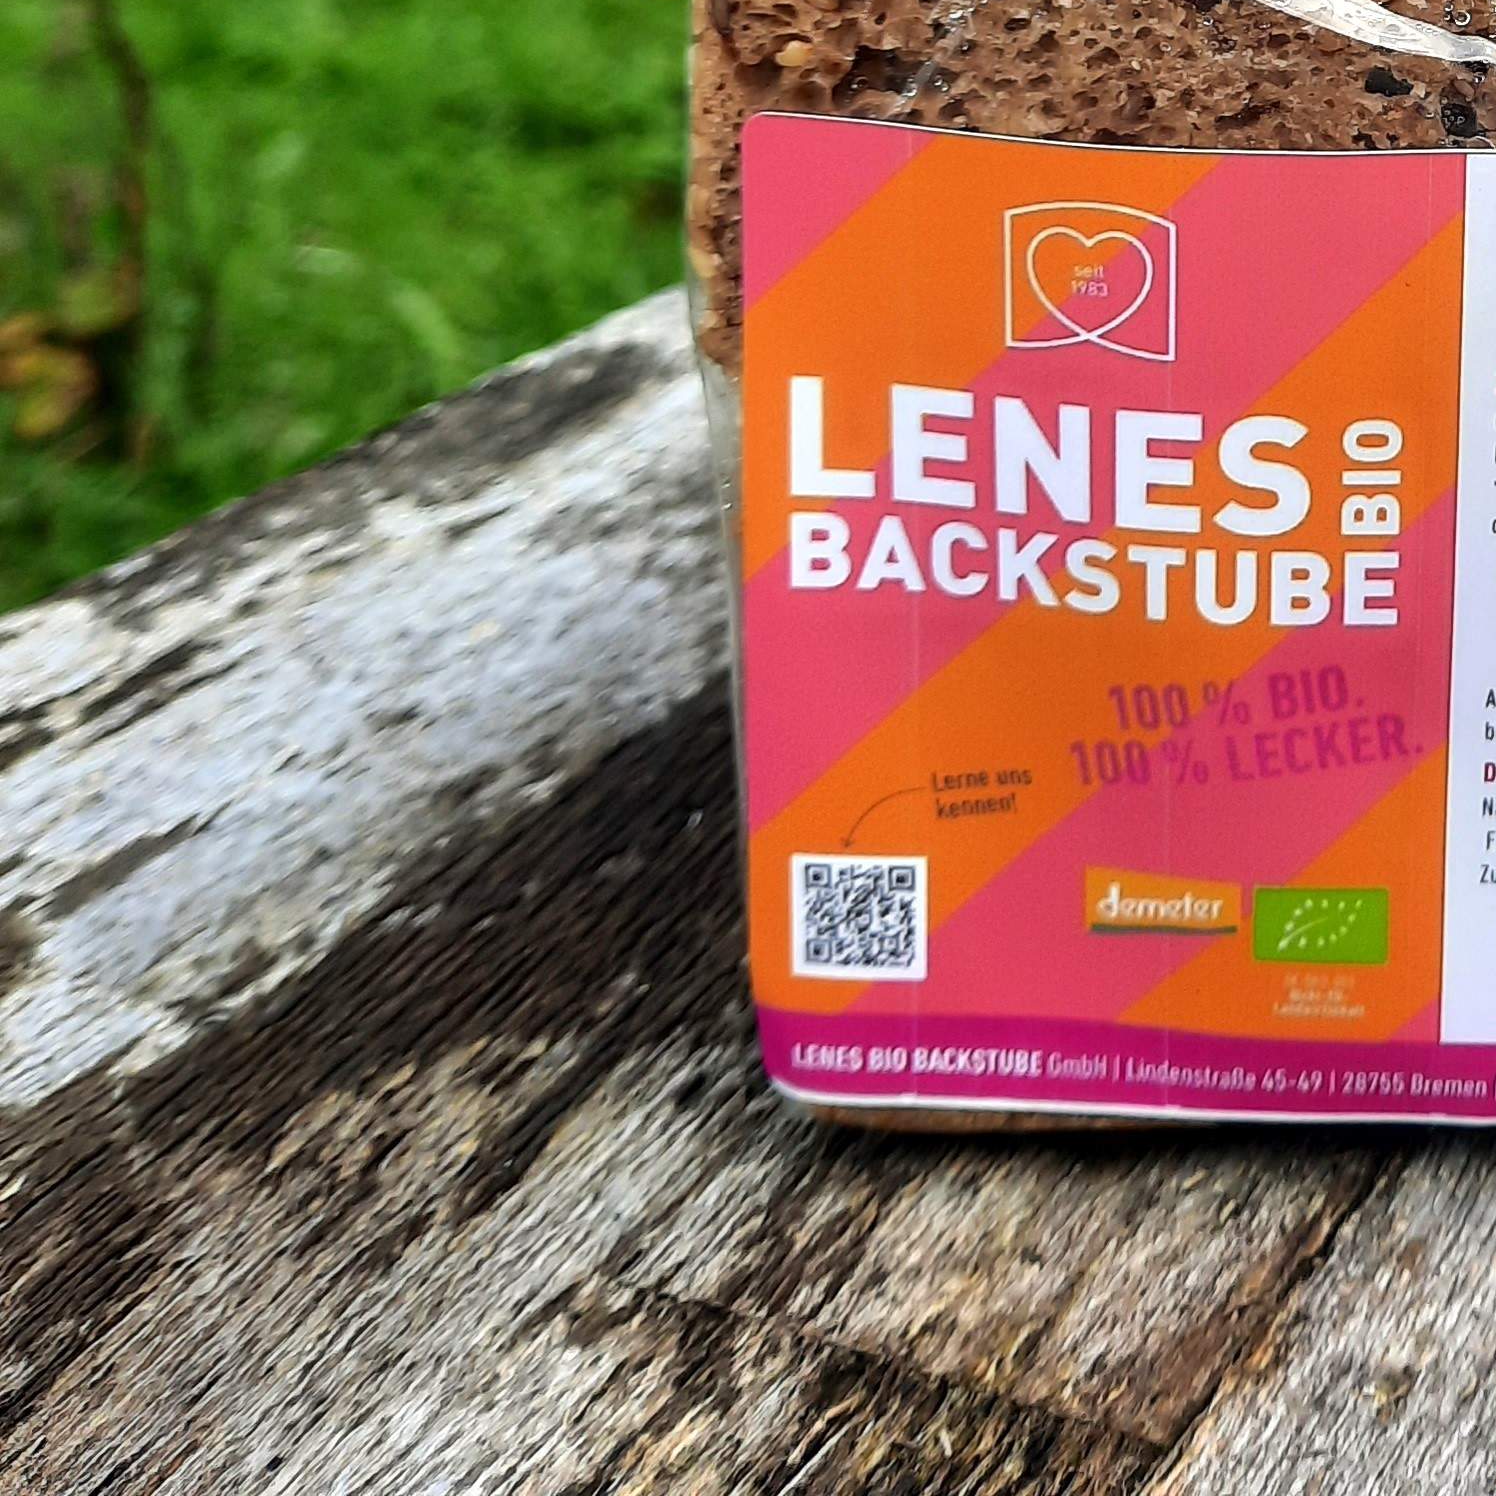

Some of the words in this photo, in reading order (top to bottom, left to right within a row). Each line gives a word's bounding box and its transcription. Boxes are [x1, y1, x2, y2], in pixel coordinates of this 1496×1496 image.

[789, 374, 1313, 538] LENES
[1340, 418, 1403, 536] BIO
[789, 511, 1399, 627] BACKSTUBE
[1108, 684, 1190, 731] 100
[1203, 679, 1250, 727] %
[1268, 665, 1365, 721] BIO.
[933, 771, 991, 792] Lerne
[997, 768, 1032, 788] uns
[1068, 739, 1151, 786] 100
[1164, 737, 1209, 785] %
[1225, 714, 1424, 781] LECKER.
[935, 794, 1017, 820] kennen!
[1096, 883, 1225, 923] demeter
[792, 1042, 863, 1072] LENES
[868, 1047, 907, 1073] BIO
[912, 1047, 1042, 1076] BACKSTUBE
[1048, 1052, 1108, 1080] GmbH
[1125, 1056, 1256, 1093] Lindenstraße
[1261, 1067, 1323, 1093] 45-49
[1410, 1073, 1487, 1098] Bremen
